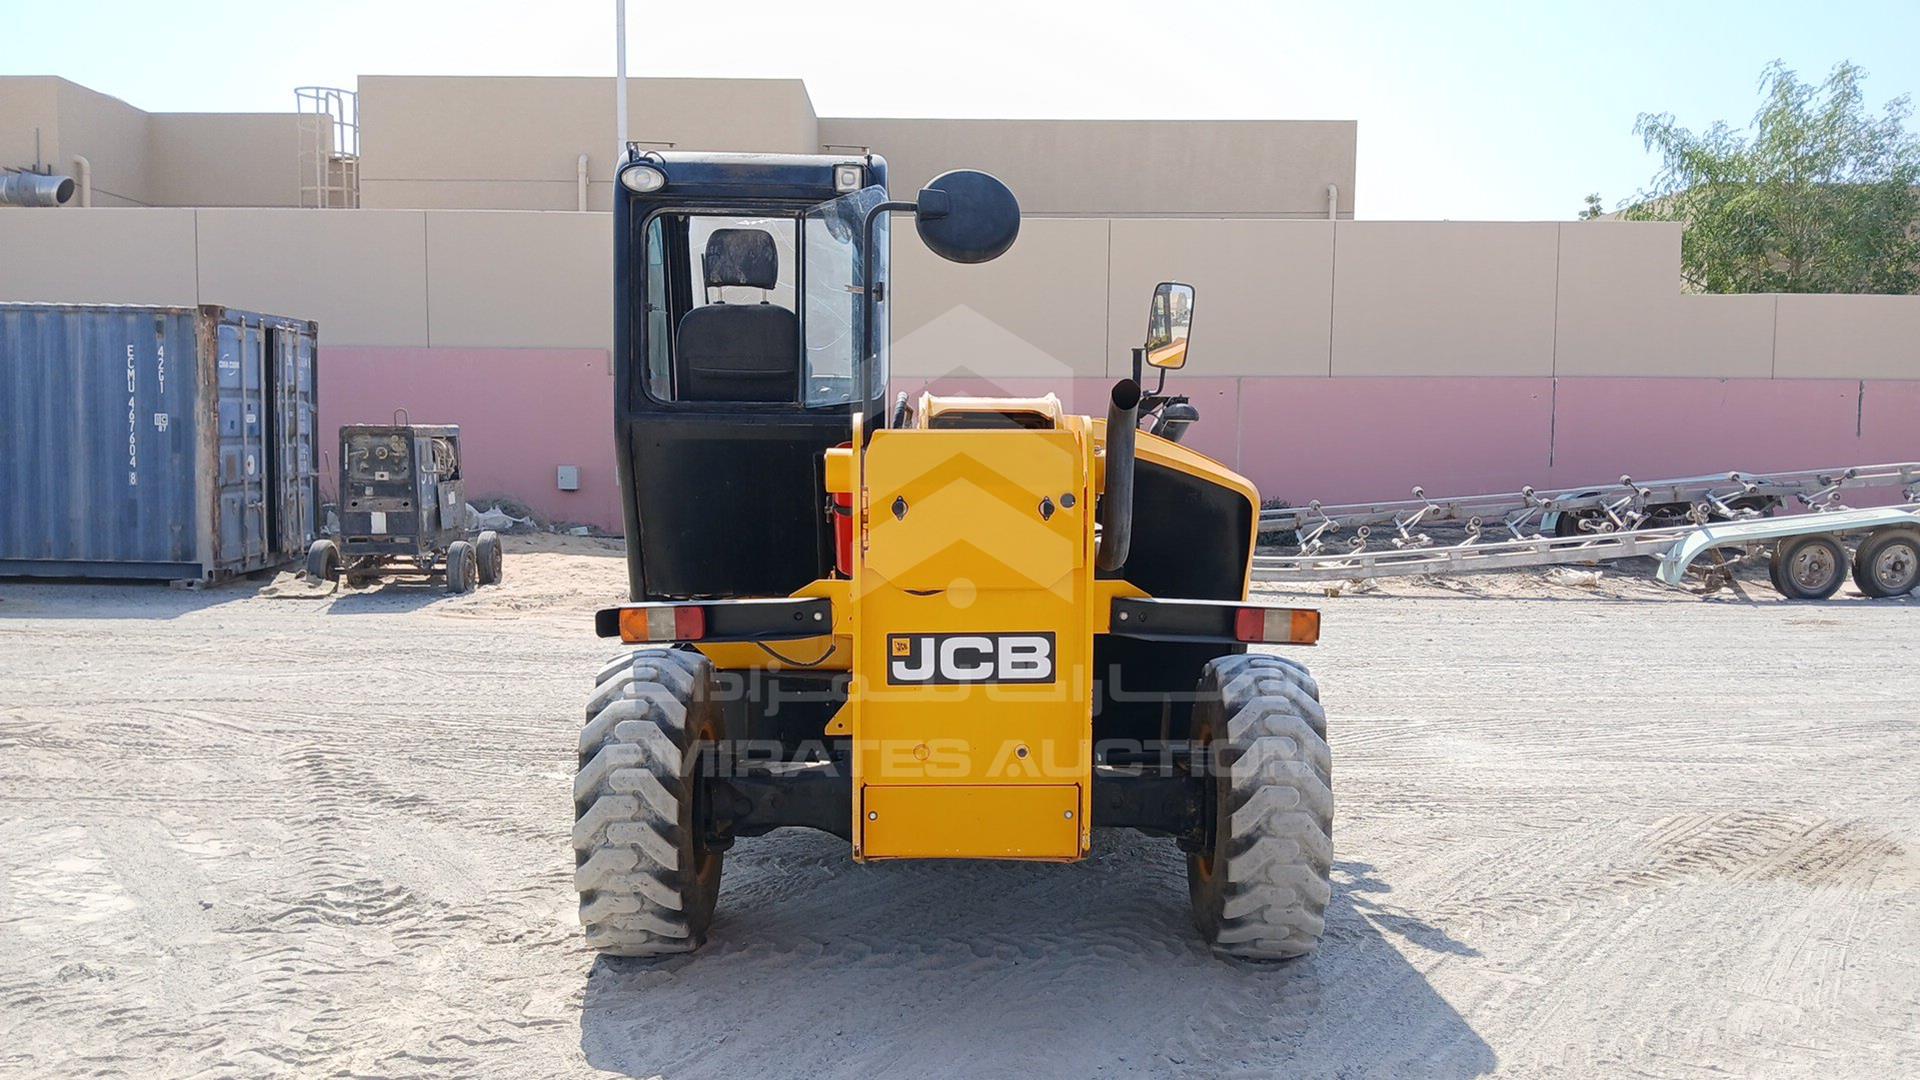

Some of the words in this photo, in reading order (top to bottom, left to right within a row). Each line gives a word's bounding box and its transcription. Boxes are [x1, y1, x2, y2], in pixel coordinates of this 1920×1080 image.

[127, 345, 135, 392] ECMU
[157, 345, 165, 393] 42G1
[128, 396, 136, 468] 467604
[892, 637, 1052, 681] JCB
